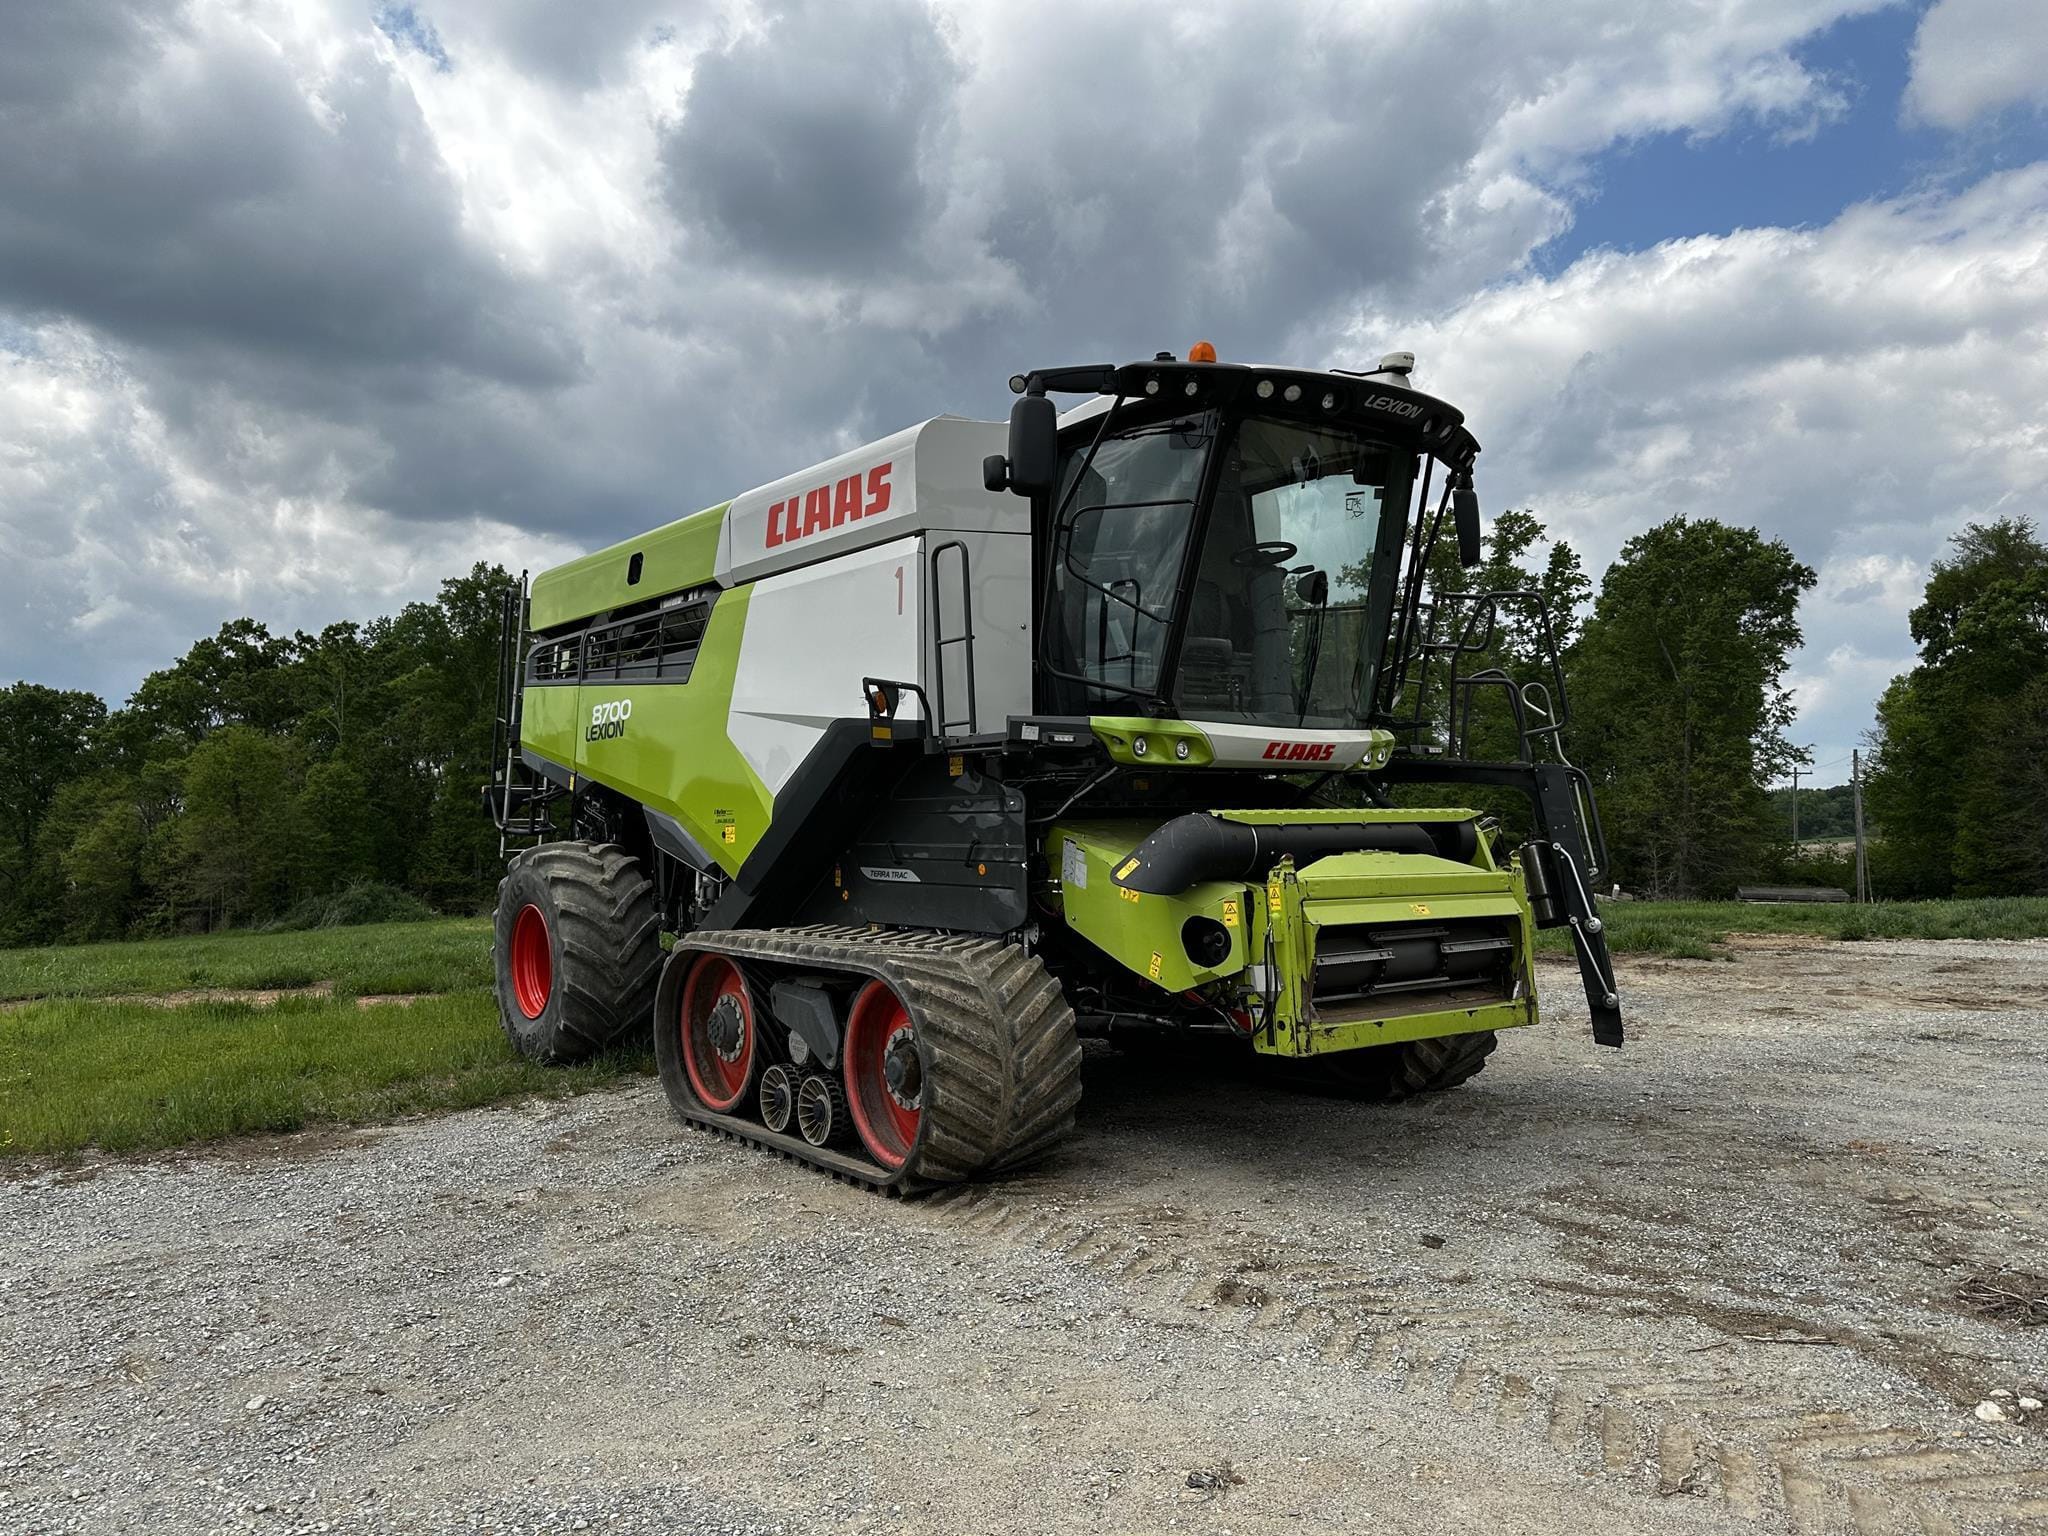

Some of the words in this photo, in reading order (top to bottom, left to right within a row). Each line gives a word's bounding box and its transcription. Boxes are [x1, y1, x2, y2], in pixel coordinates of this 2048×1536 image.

[1364, 394, 1424, 418] LEXION
[765, 461, 892, 549] CLAAS
[894, 566, 904, 616] 1
[592, 698, 632, 725] 8700
[585, 719, 625, 742] LEXION
[1262, 742, 1337, 761] CLAAS
[870, 870, 890, 878] TERRA
[891, 871, 909, 879] TRAC
